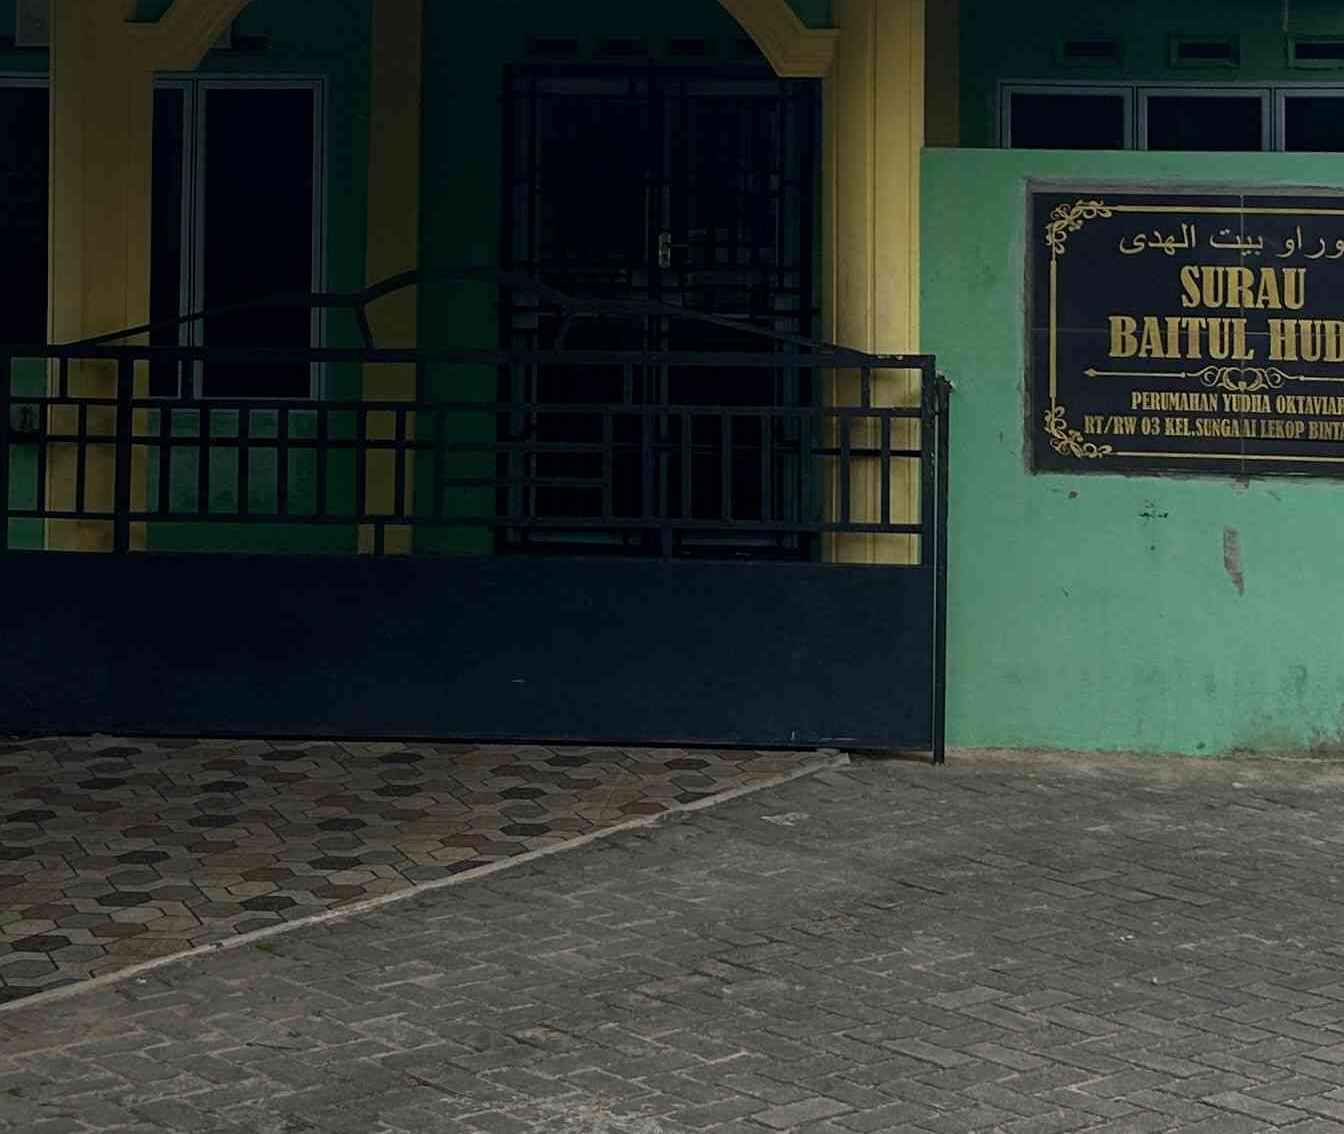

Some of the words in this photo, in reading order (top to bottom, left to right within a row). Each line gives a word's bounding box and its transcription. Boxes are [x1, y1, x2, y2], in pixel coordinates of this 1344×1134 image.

[1119, 222, 1197, 256] الهدى
[1209, 227, 1264, 257] بيت
[1179, 264, 1307, 310] SURAU
[1108, 315, 1255, 361] BAITUL
[1130, 391, 1218, 412] PERUMAHAN
[1222, 393, 1272, 413] YUDHA
[1083, 415, 1137, 435] RT/RW
[1140, 416, 1161, 436] 03
[1260, 419, 1305, 440] LEKOP
